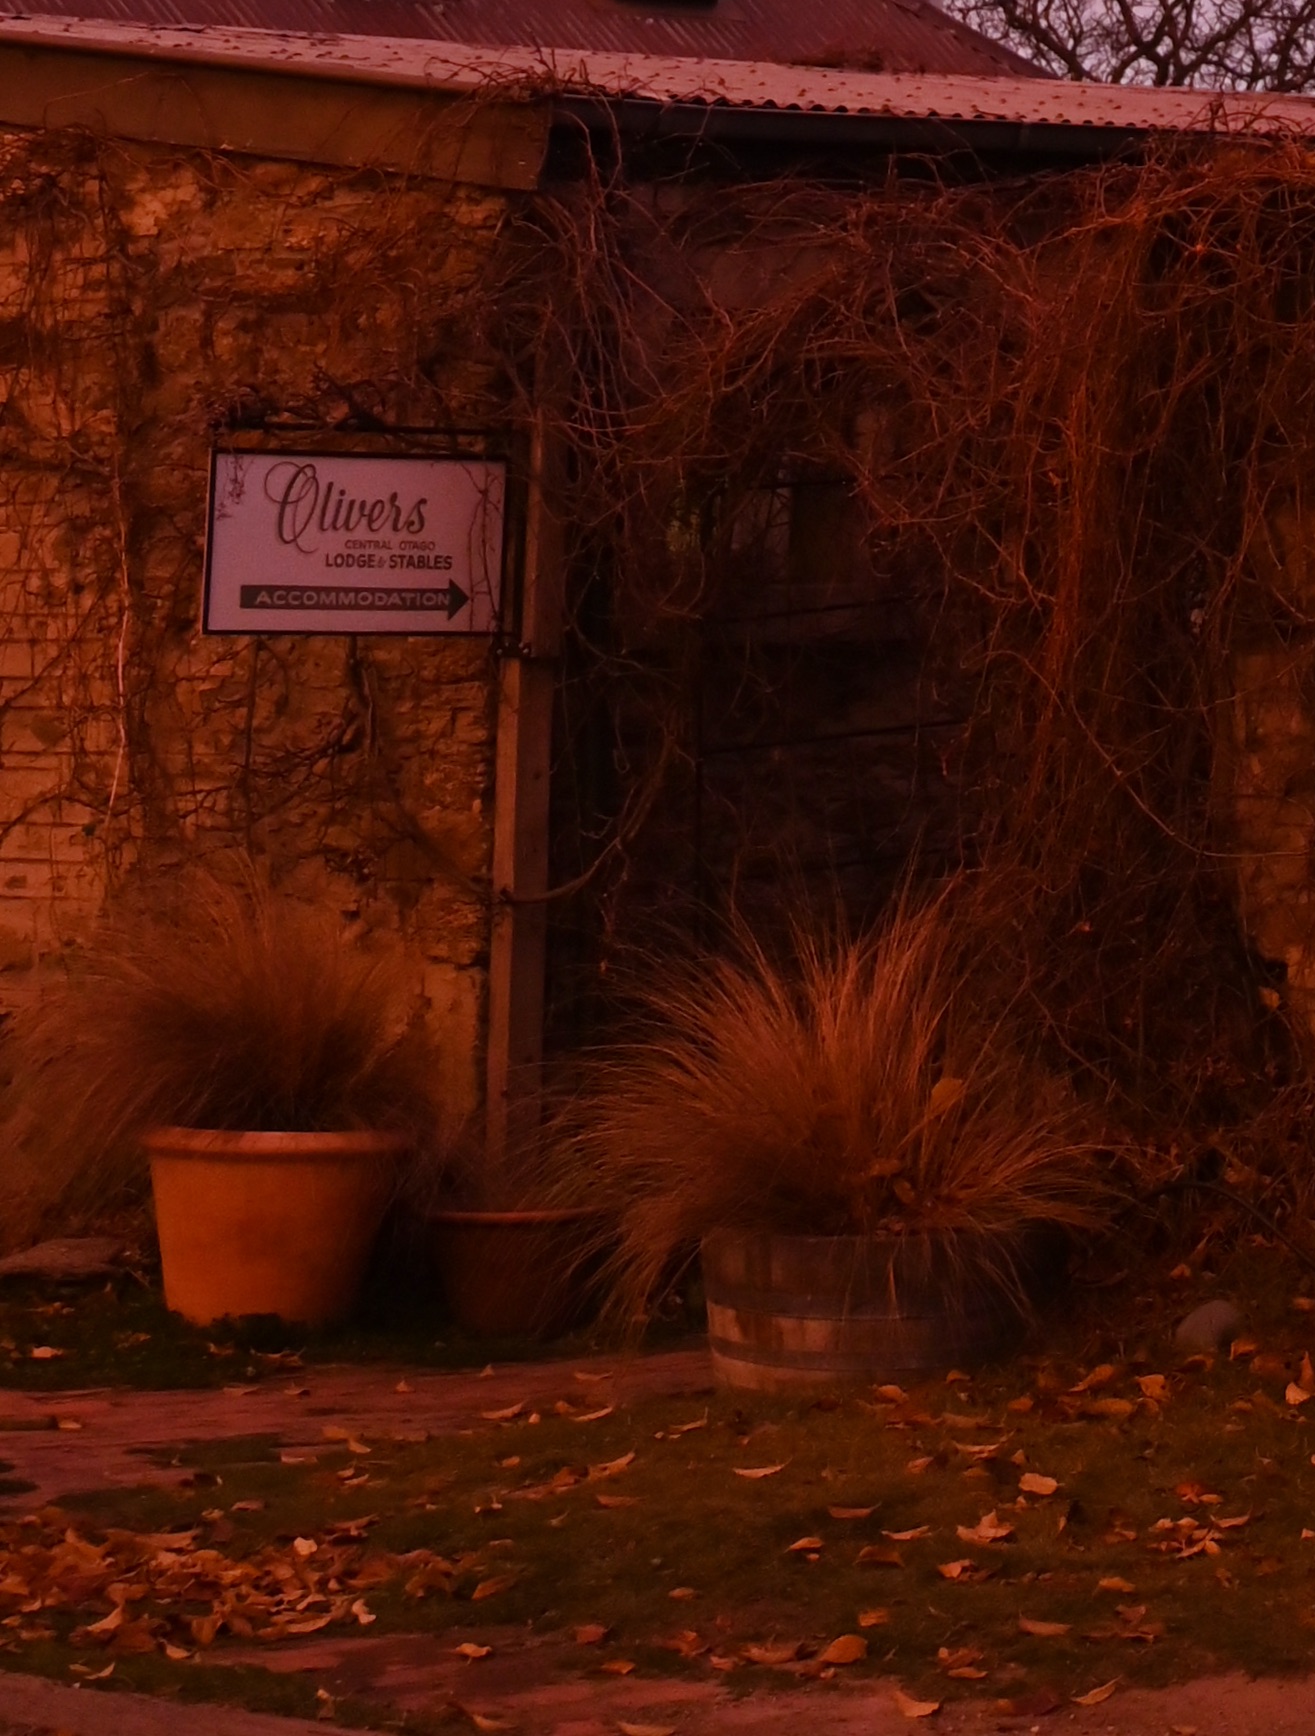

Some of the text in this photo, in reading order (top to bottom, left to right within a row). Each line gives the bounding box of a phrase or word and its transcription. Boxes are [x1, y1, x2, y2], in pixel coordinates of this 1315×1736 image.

[264, 461, 428, 553] Olivers
[344, 539, 436, 551] CENTRAL OTAGO
[326, 553, 375, 568] LODGE
[389, 554, 453, 570] STABLES
[255, 590, 450, 606] ACCOMMODATION
